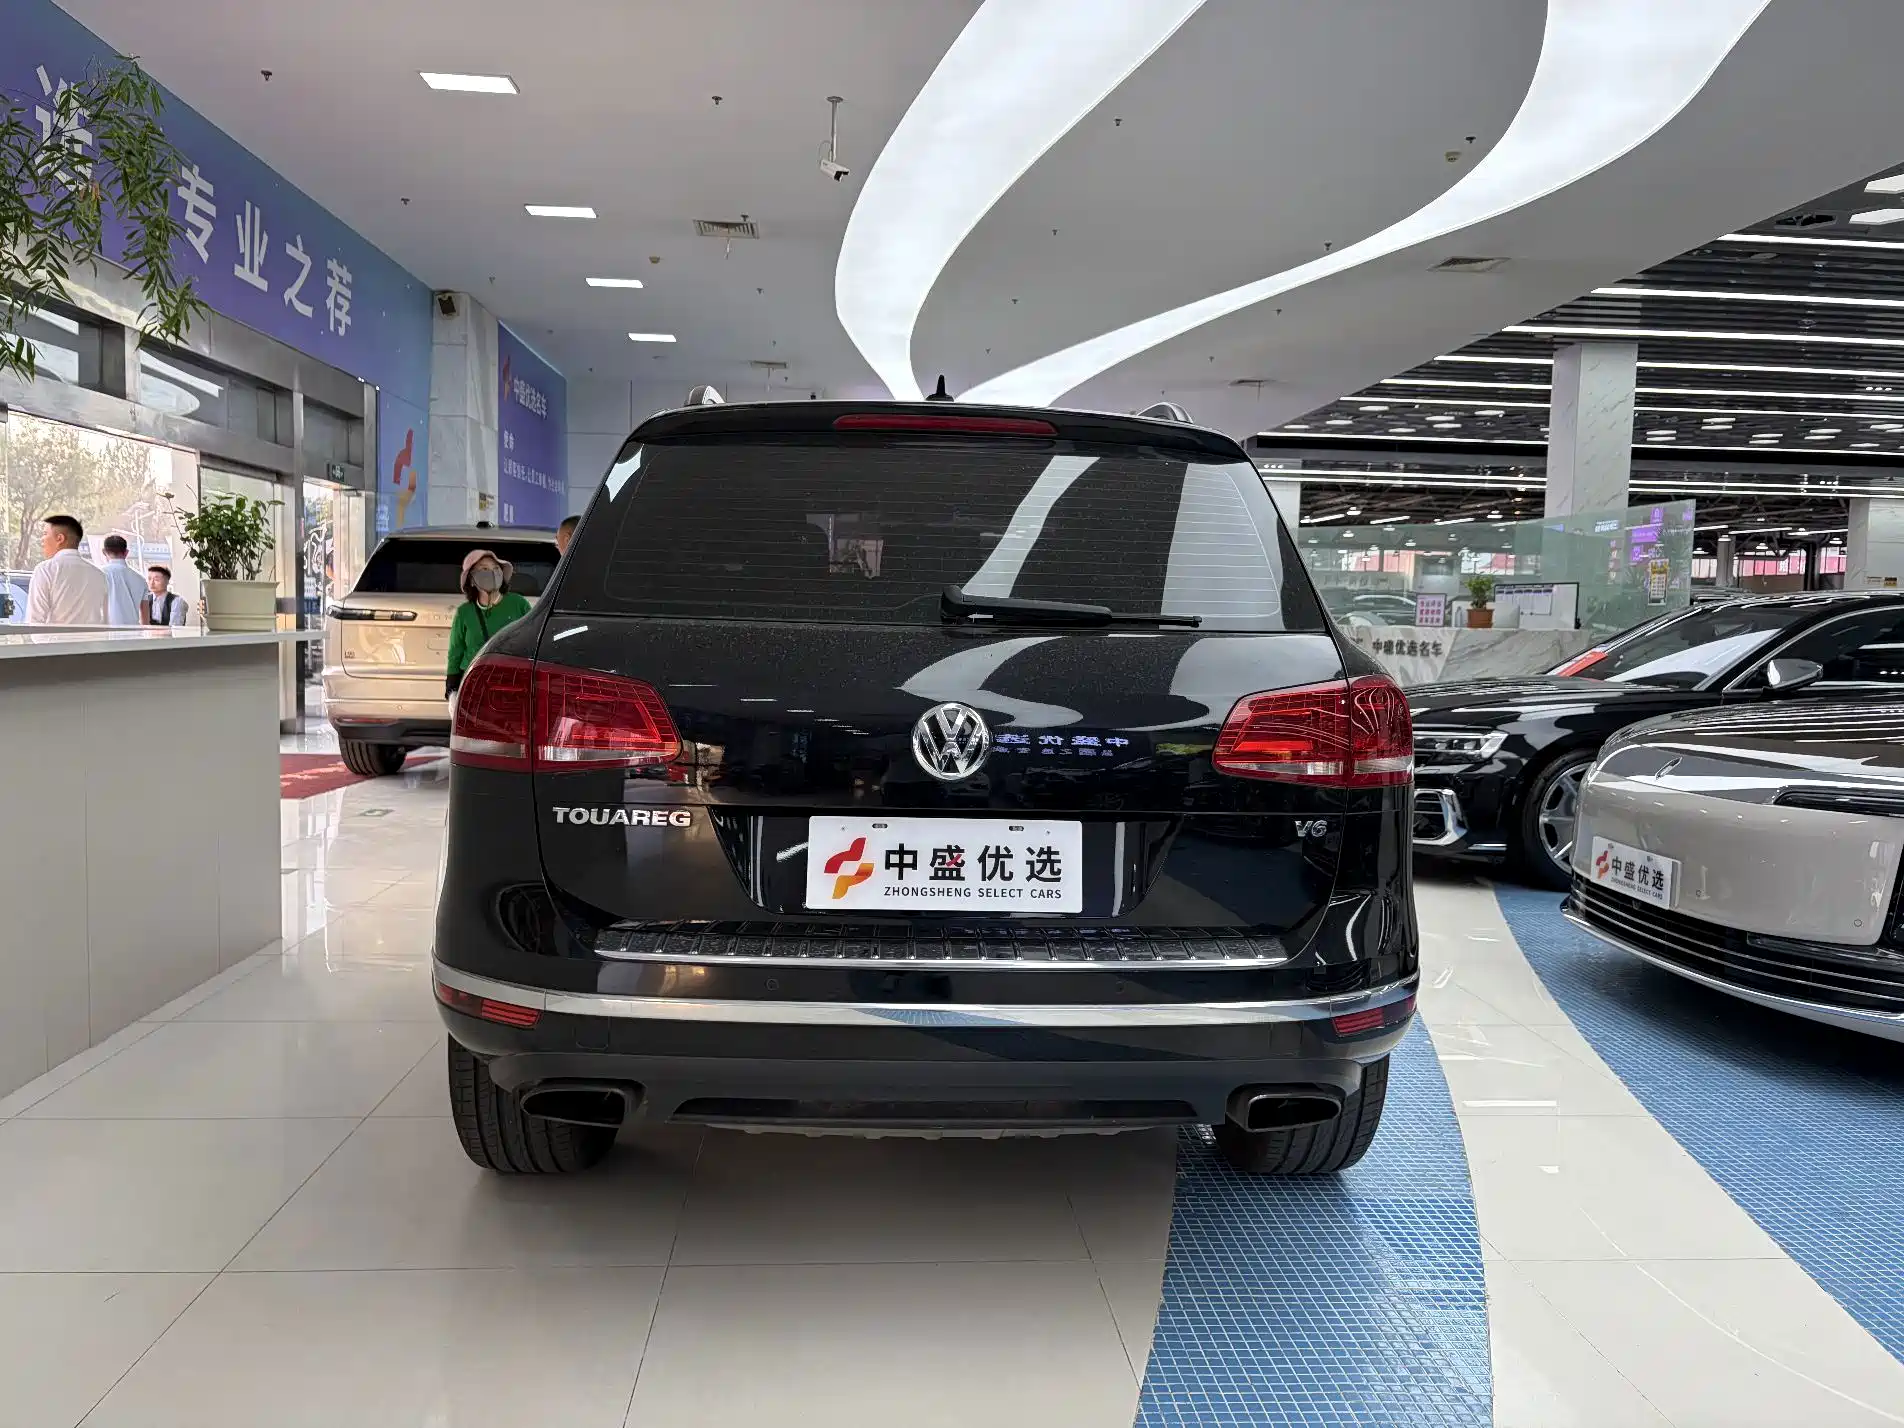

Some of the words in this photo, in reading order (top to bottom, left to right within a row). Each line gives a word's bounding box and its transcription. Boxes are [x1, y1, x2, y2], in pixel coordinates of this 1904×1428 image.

[177, 163, 353, 337] 专业之荐
[1372, 638, 1442, 657] 中盛优选名车
[552, 806, 692, 827] TOUAREG
[1294, 819, 1328, 837] V6
[884, 843, 1062, 883] 中盛优选
[1611, 855, 1664, 891] 中盛优选
[884, 886, 971, 898] ZHONGSHENG
[977, 887, 1023, 898] SELECT
[1030, 888, 1062, 899] CARS
